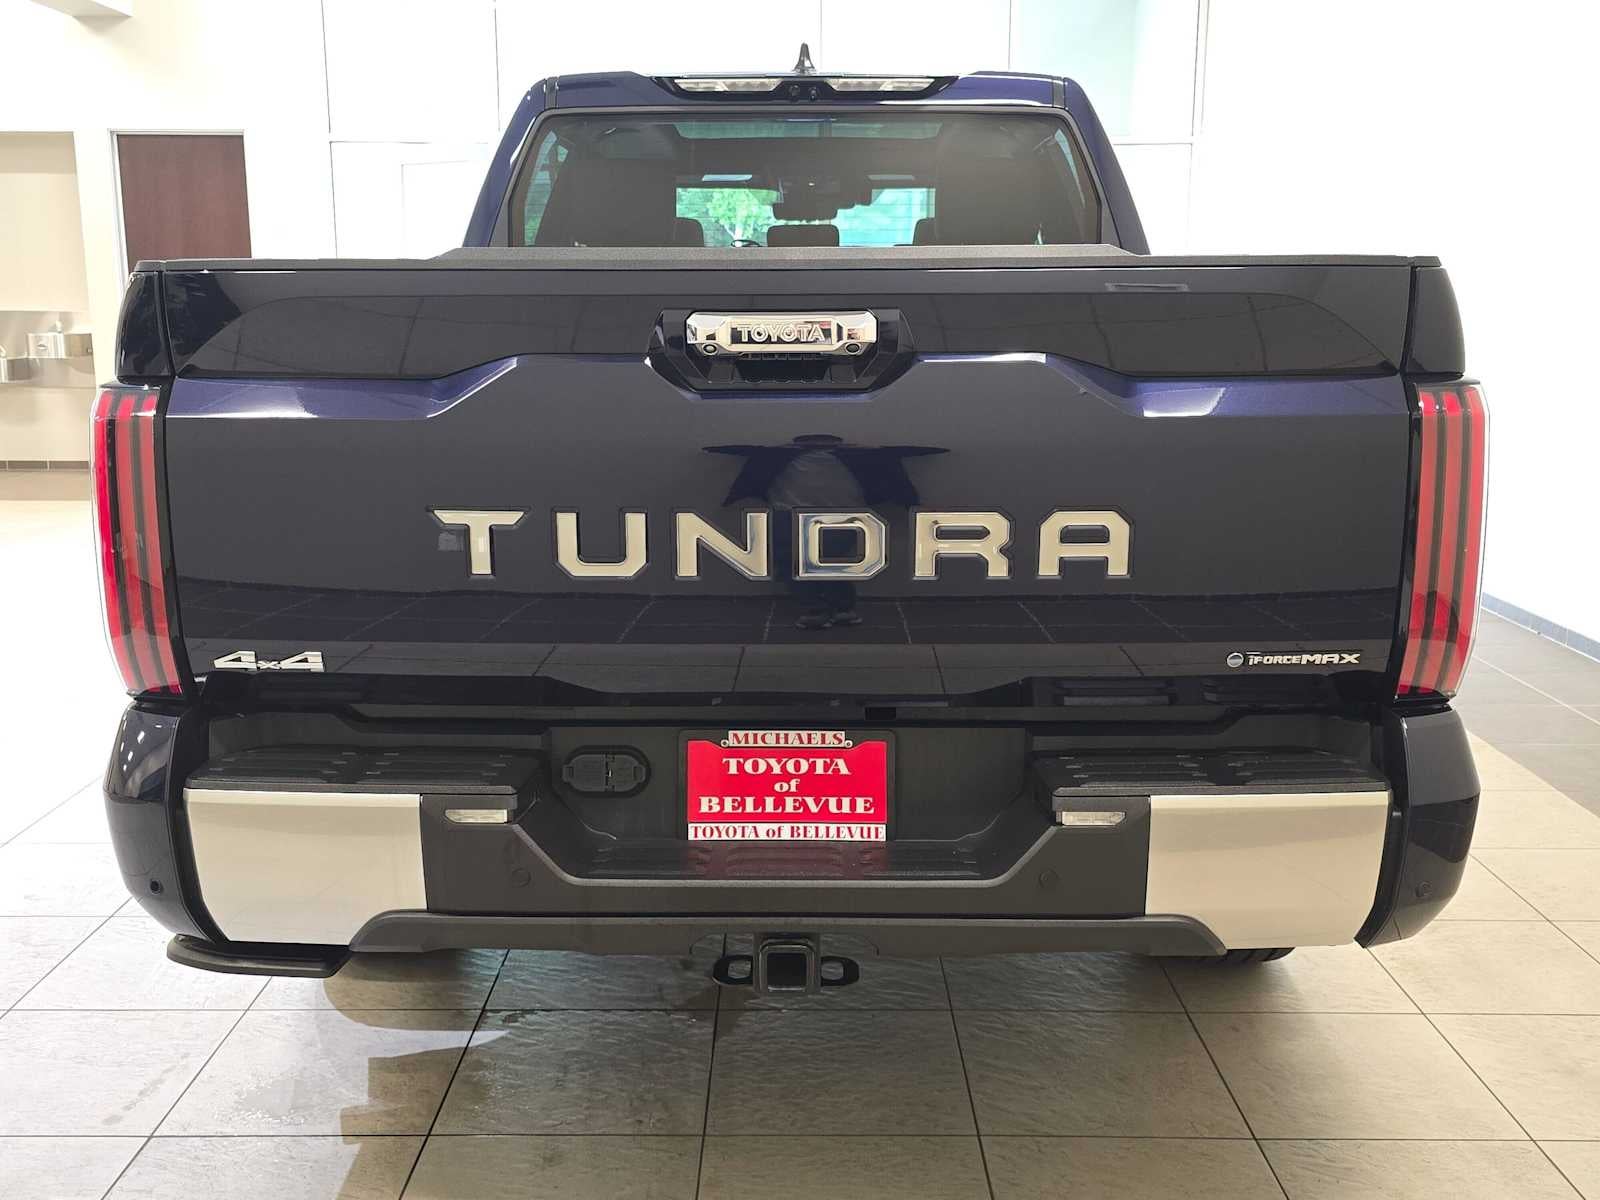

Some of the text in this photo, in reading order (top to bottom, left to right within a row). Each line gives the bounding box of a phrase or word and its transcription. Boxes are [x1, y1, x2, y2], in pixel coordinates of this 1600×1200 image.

[736, 323, 826, 342] TOYOTA
[432, 509, 1133, 580] TUNDRA
[731, 731, 844, 746] MICHAELS
[722, 757, 852, 775] TOYOTA
[773, 778, 800, 793] of
[698, 795, 875, 814] BELLEVUE
[690, 824, 885, 840] TOYOTA of BELLEVUE
